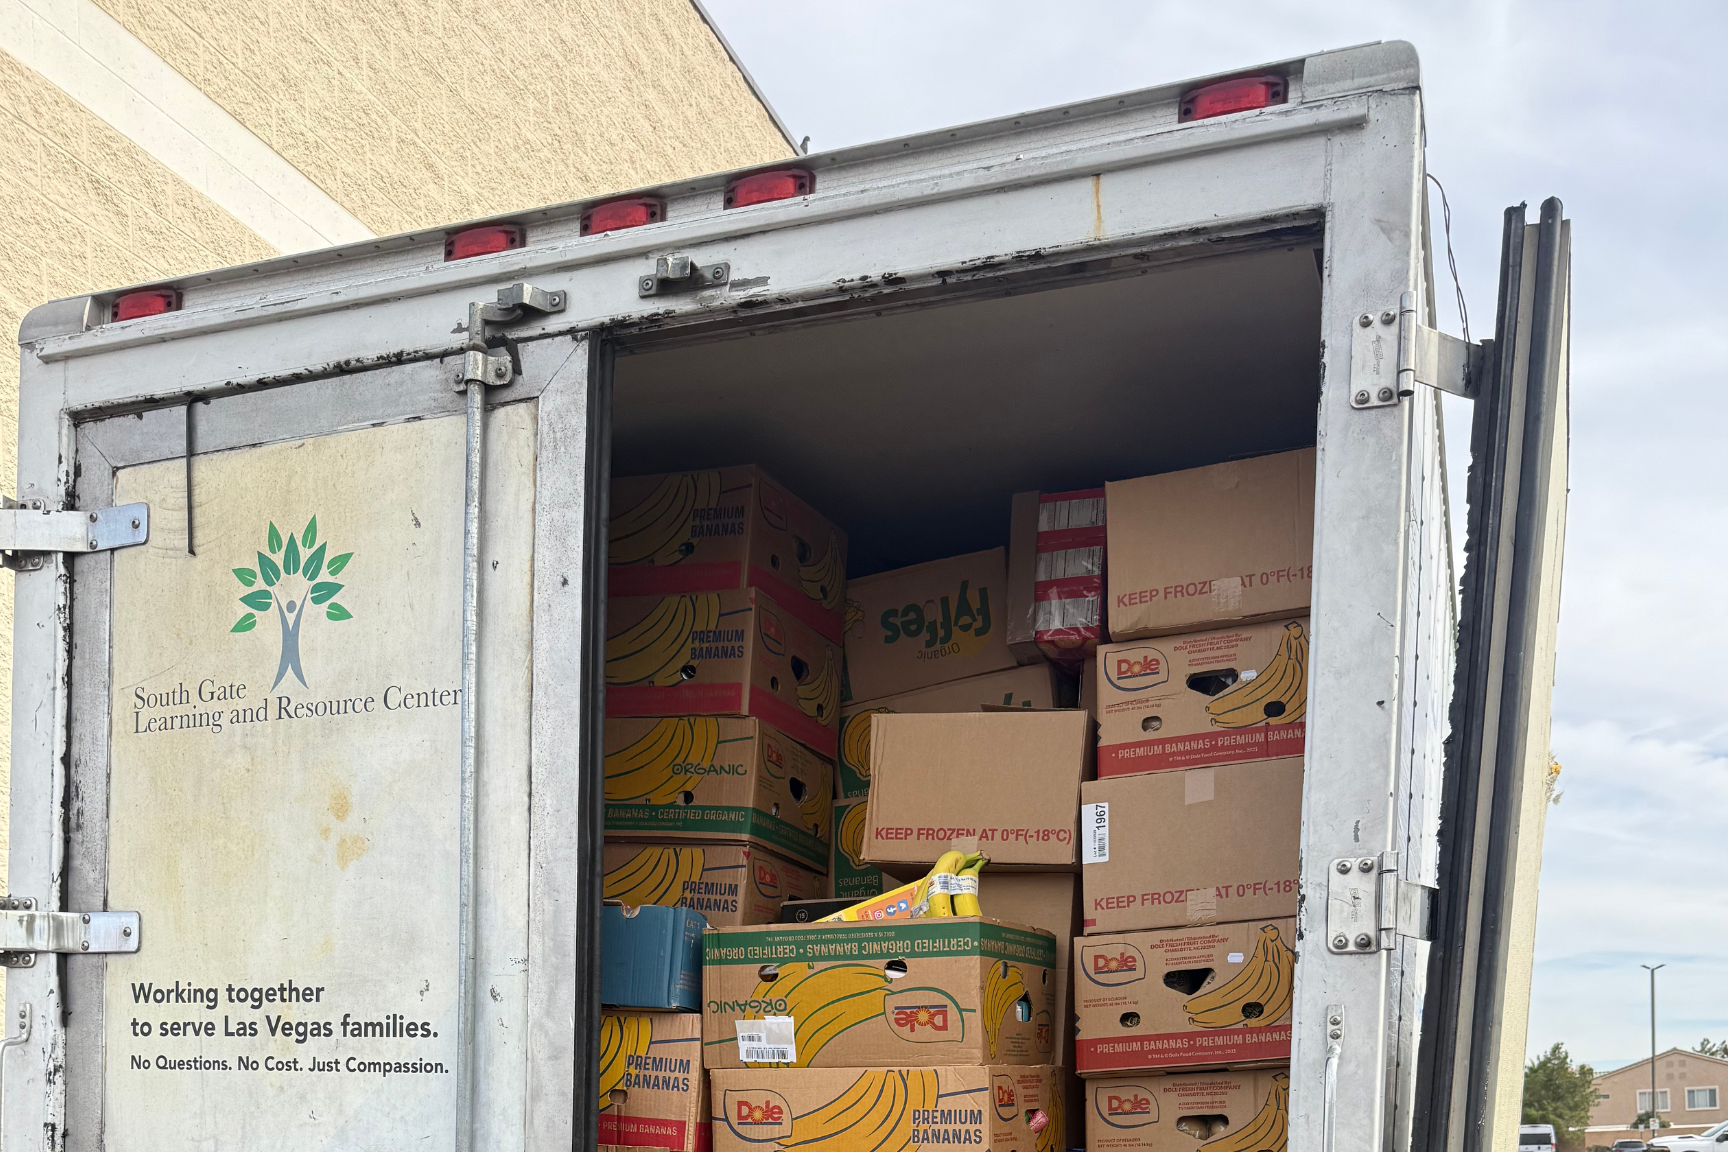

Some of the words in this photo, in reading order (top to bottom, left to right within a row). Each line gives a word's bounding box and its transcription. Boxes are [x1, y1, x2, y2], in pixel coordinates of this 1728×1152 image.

[692, 506, 745, 522] PREMIUM
[690, 522, 744, 538] BANANAS
[1117, 588, 1160, 608] KEEP
[692, 629, 744, 644] PREMIUM
[690, 645, 744, 660] BANANAS
[916, 642, 961, 662] Organic
[1116, 655, 1160, 678] Dole
[134, 680, 190, 710] South
[198, 678, 247, 704] Gate
[133, 704, 224, 734] Learning
[230, 698, 268, 725] and
[276, 693, 375, 721] Resource
[383, 685, 462, 711] Center
[766, 742, 783, 766] Dole
[1118, 744, 1163, 760] PREMIUM
[1165, 739, 1210, 754] BANANAS
[1218, 732, 1265, 747] PREMIUM
[672, 762, 748, 776] ORGANIC
[608, 808, 650, 819] BANANAS
[657, 809, 702, 821] CERTIFIED
[704, 810, 745, 822] ORGANIC
[1095, 804, 1106, 830] 1967
[874, 828, 913, 840] KEEP
[916, 828, 976, 841] FROZEN
[978, 828, 998, 841] AT
[1000, 828, 1072, 845] 0°F(-18°C)
[758, 866, 777, 885] Dole
[838, 875, 878, 887] Bananas
[682, 880, 738, 896] PREMIUM
[680, 897, 738, 913] BANANAS
[1094, 894, 1136, 911] KEEP
[706, 946, 746, 960] ORGANIC
[748, 944, 796, 958] CERTIFIED
[806, 942, 859, 957] BANANAS
[862, 940, 912, 955] ORGANIC
[914, 937, 972, 952] CERTIFIED
[1093, 952, 1137, 972] Dole
[131, 982, 218, 1010] Working
[226, 979, 325, 1010] together
[706, 998, 787, 1014] ORGANIC
[131, 1018, 152, 1037] to
[160, 1020, 216, 1038] serve
[224, 1016, 258, 1038] Las
[265, 1015, 333, 1044] Vegas
[341, 1014, 439, 1039] families.
[894, 1009, 948, 1032] Dole
[1096, 1041, 1141, 1054] PREMIUM
[1143, 1038, 1189, 1051] BANANAS
[1196, 1034, 1243, 1047] PREMIUM
[1245, 1030, 1292, 1044] BANANAS
[130, 1056, 151, 1070] No
[155, 1055, 232, 1072] Questions.
[238, 1056, 260, 1072] No
[264, 1056, 303, 1072] Cost.
[308, 1057, 340, 1073] Just
[345, 1057, 449, 1078] Compassion.
[626, 1054, 691, 1074] PREMIUM
[624, 1072, 690, 1092] BANANAS
[998, 1085, 1014, 1105] Dole
[1108, 1094, 1150, 1114] Dole
[736, 1099, 784, 1122] Dole
[912, 1109, 983, 1125] PREMIUM
[602, 1121, 637, 1133] PREMIUM
[639, 1123, 678, 1136] BANANAS
[912, 1128, 983, 1145] BANANAS
